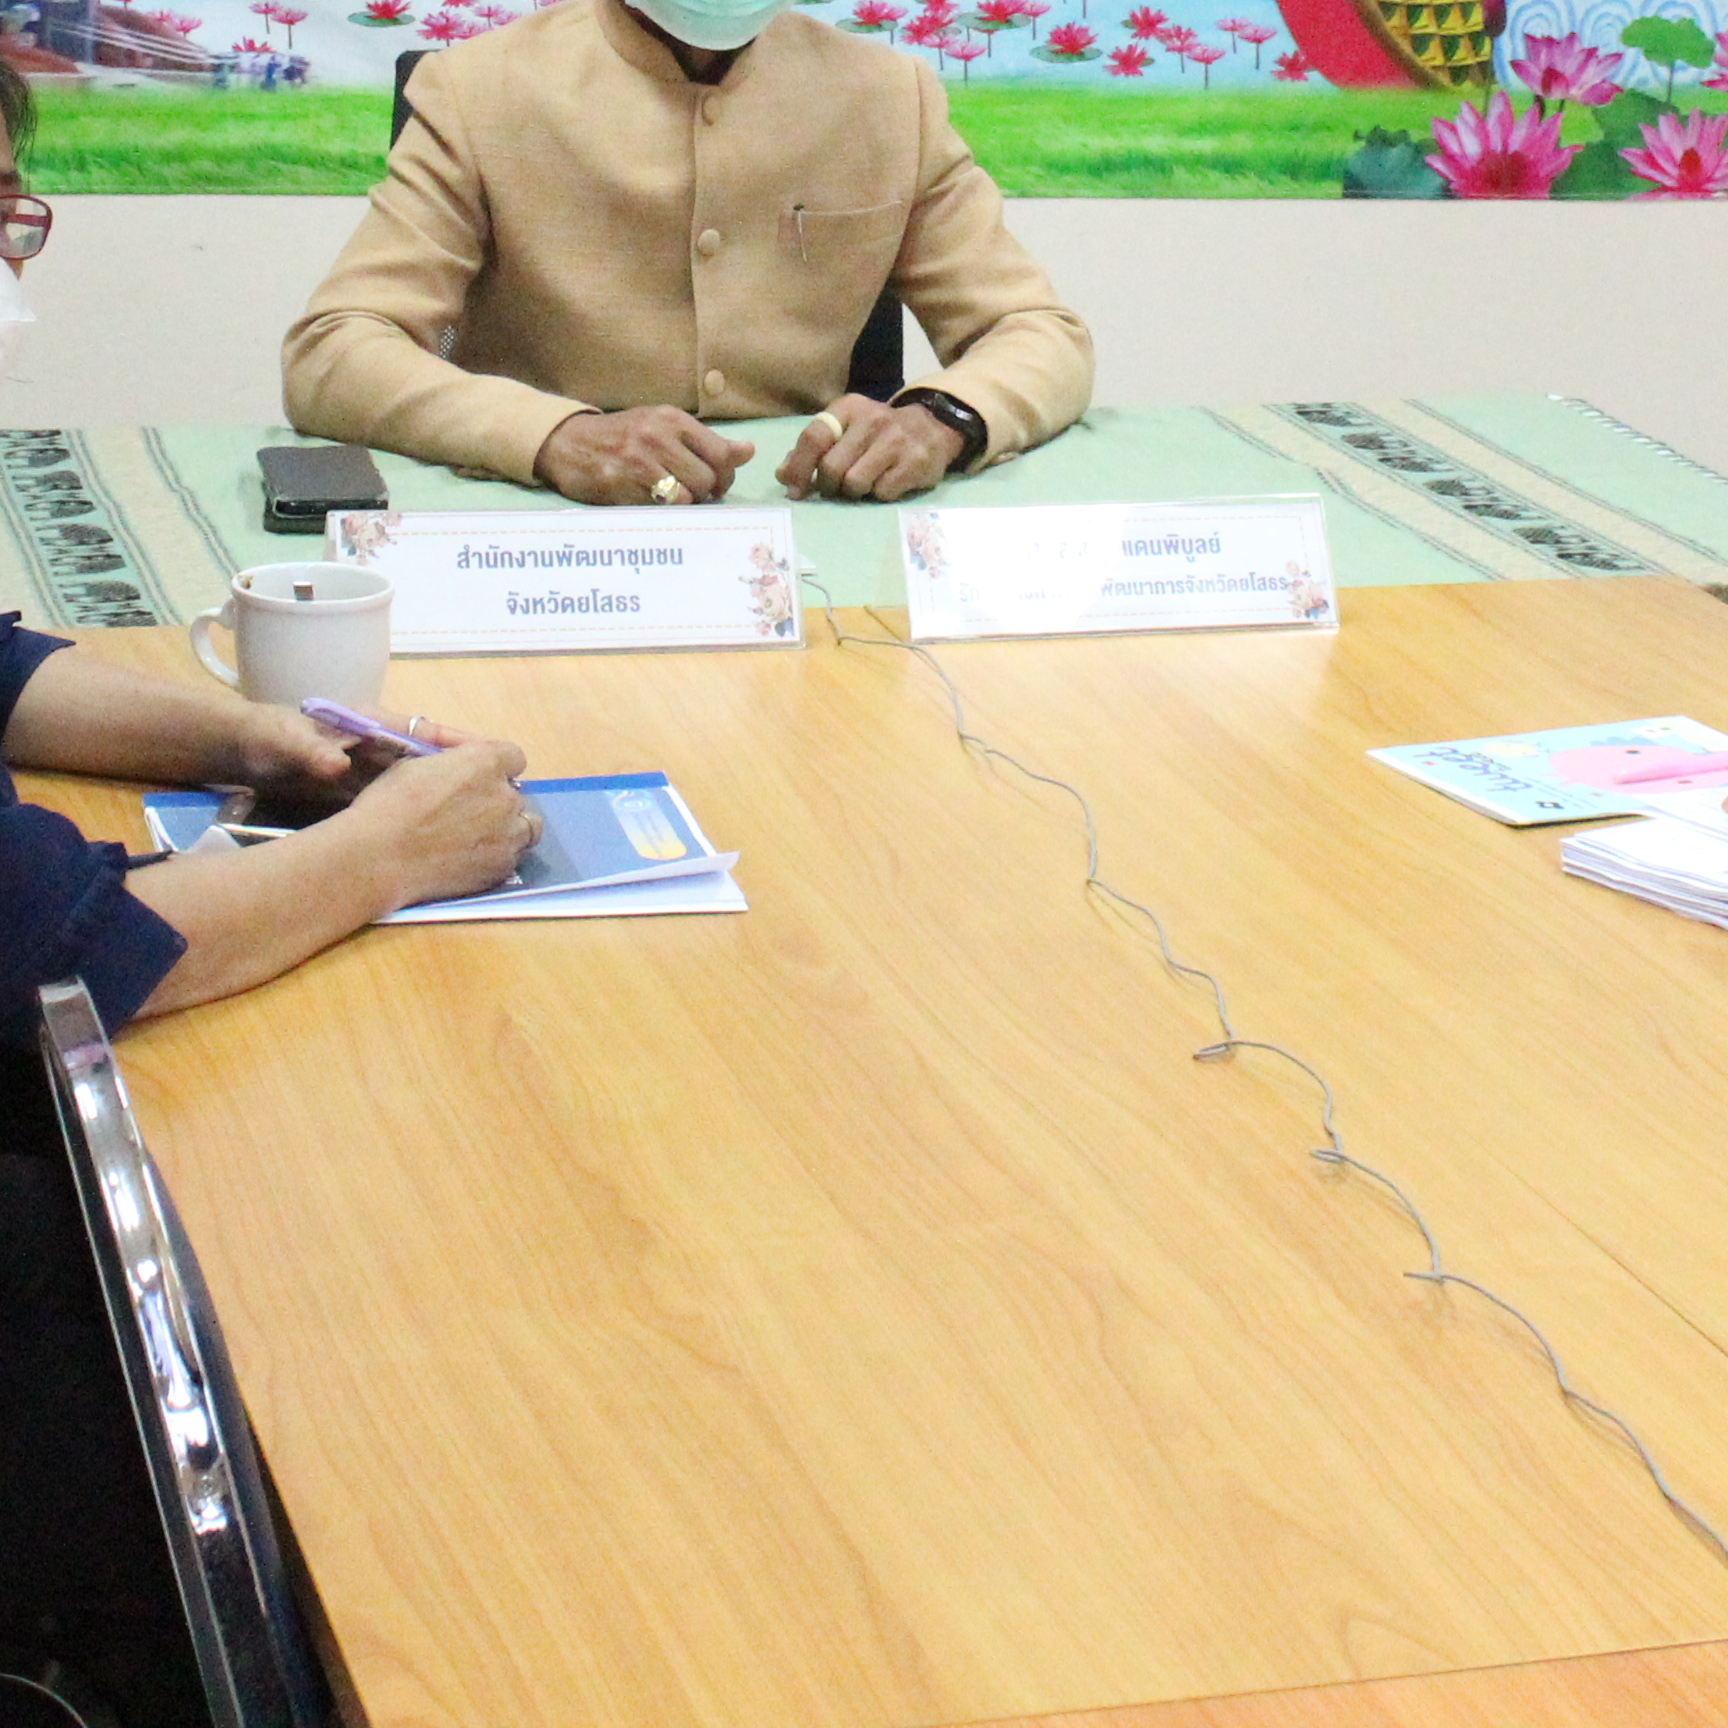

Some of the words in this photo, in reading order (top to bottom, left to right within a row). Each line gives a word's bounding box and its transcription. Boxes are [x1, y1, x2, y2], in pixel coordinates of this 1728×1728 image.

[456, 543, 684, 575] สำนักงานพัฒนาชุมชน
[506, 587, 642, 616] จังหวัดยโสธร
